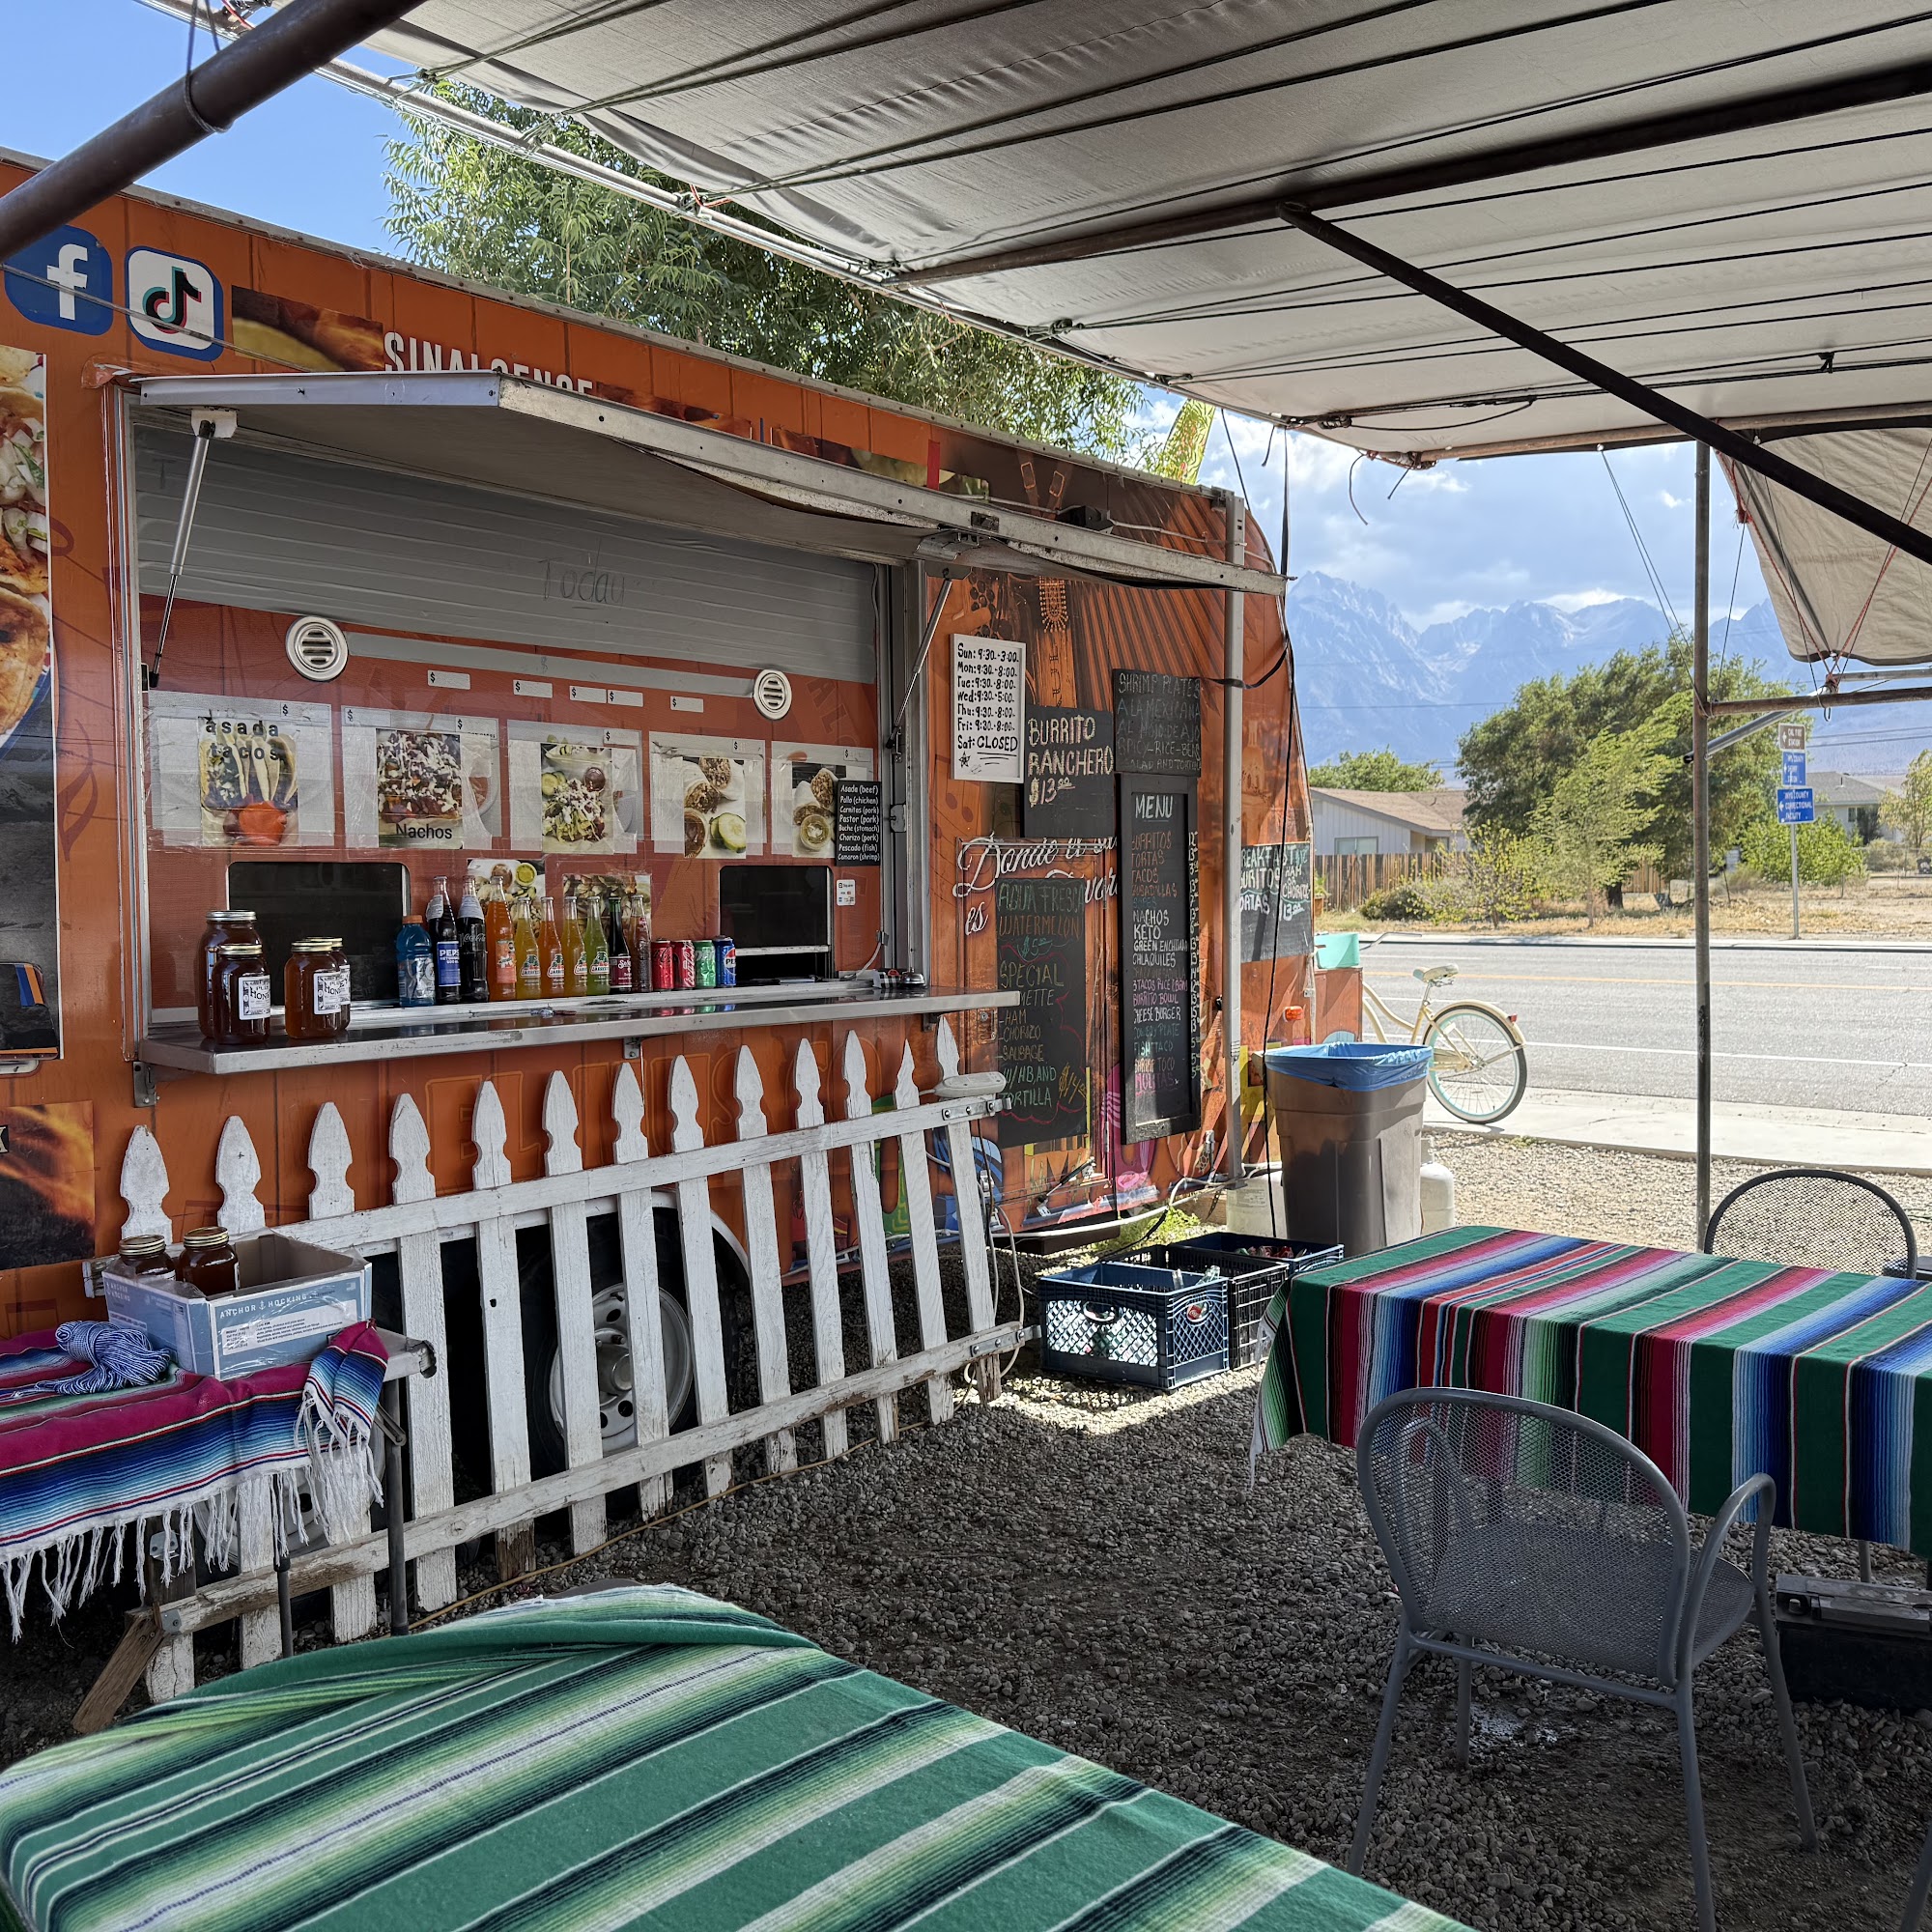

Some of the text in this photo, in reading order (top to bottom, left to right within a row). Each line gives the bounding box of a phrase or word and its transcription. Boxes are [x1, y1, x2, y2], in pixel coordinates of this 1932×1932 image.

[1119, 672, 1158, 694] SHRIMP
[206, 720, 279, 737] asada
[1027, 714, 1095, 747] BURRITO
[211, 742, 279, 761] tacos
[957, 735, 1019, 752] Sat: CLOSED
[1027, 745, 1114, 778] RANCHERO
[840, 784, 879, 795] Asada (beef)
[1794, 791, 1809, 800] COUNTY
[853, 796, 879, 806] (chicken)
[1135, 793, 1174, 819] MENU
[838, 814, 880, 825] Pastor (pork)
[395, 823, 453, 839] Nachos
[854, 824, 880, 833] (stomach)
[861, 834, 879, 843] (pork)
[838, 843, 878, 853] Pescado (fish)
[859, 853, 880, 862] (shrimp)
[1131, 849, 1165, 868] TORTAS
[1131, 868, 1159, 884] TACOS
[1285, 864, 1303, 878] HAM
[999, 882, 1037, 914] AGUA
[1038, 883, 1086, 914] FRESCA
[966, 901, 989, 936] es
[1133, 909, 1170, 926] NACHOS
[999, 916, 1083, 941] WATERMELON
[1133, 923, 1162, 940] KETO
[1133, 940, 1157, 952] GREEN
[999, 961, 1065, 989] SPECIAL
[1137, 979, 1156, 992] TACOS
[1158, 992, 1179, 1006] BOWL
[1154, 1006, 1181, 1021] BURGER
[1151, 1038, 1174, 1054] TACO
[219, 1304, 257, 1320] ANCHOR
[268, 1293, 308, 1308] HOCKING
